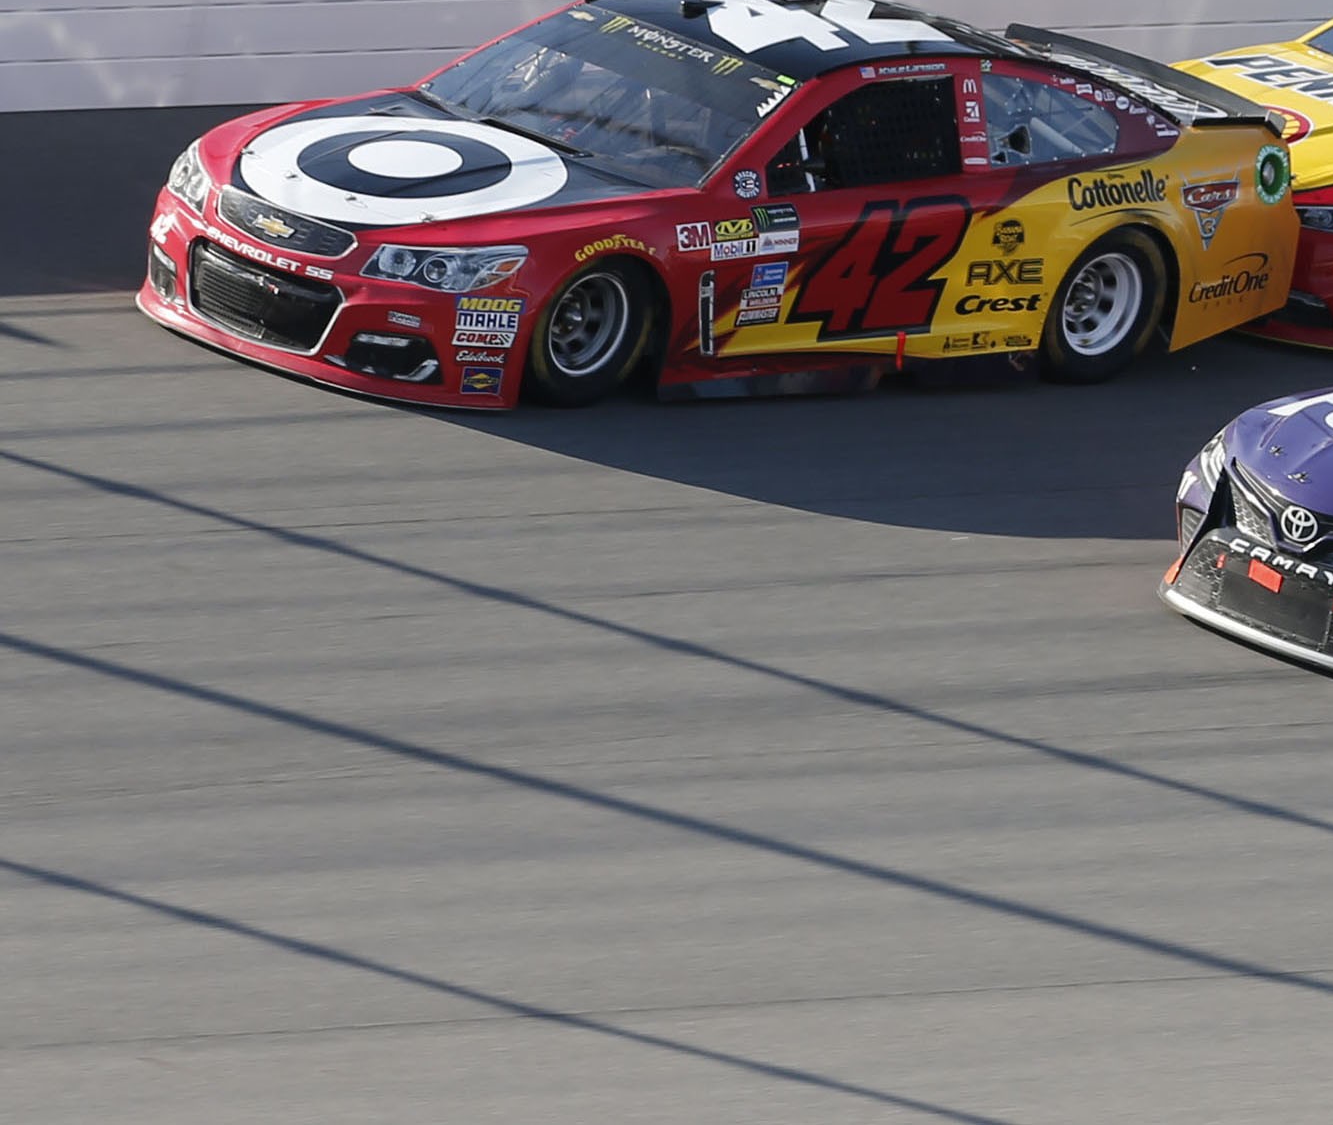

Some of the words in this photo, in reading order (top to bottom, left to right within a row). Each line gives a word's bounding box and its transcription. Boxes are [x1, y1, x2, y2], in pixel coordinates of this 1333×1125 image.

[627, 24, 715, 62] MONSTER
[1067, 169, 1167, 211] Cottonelle
[1187, 188, 1232, 205] Cars
[679, 222, 710, 250] 3M
[714, 242, 744, 256] Mobil
[206, 227, 301, 271] CHEVROLET
[305, 266, 334, 280] SS
[786, 194, 973, 342] 42
[966, 258, 1044, 287] AXE
[459, 297, 522, 311] MOOG
[955, 294, 1042, 316] Crest
[457, 313, 518, 329] MAHLE
